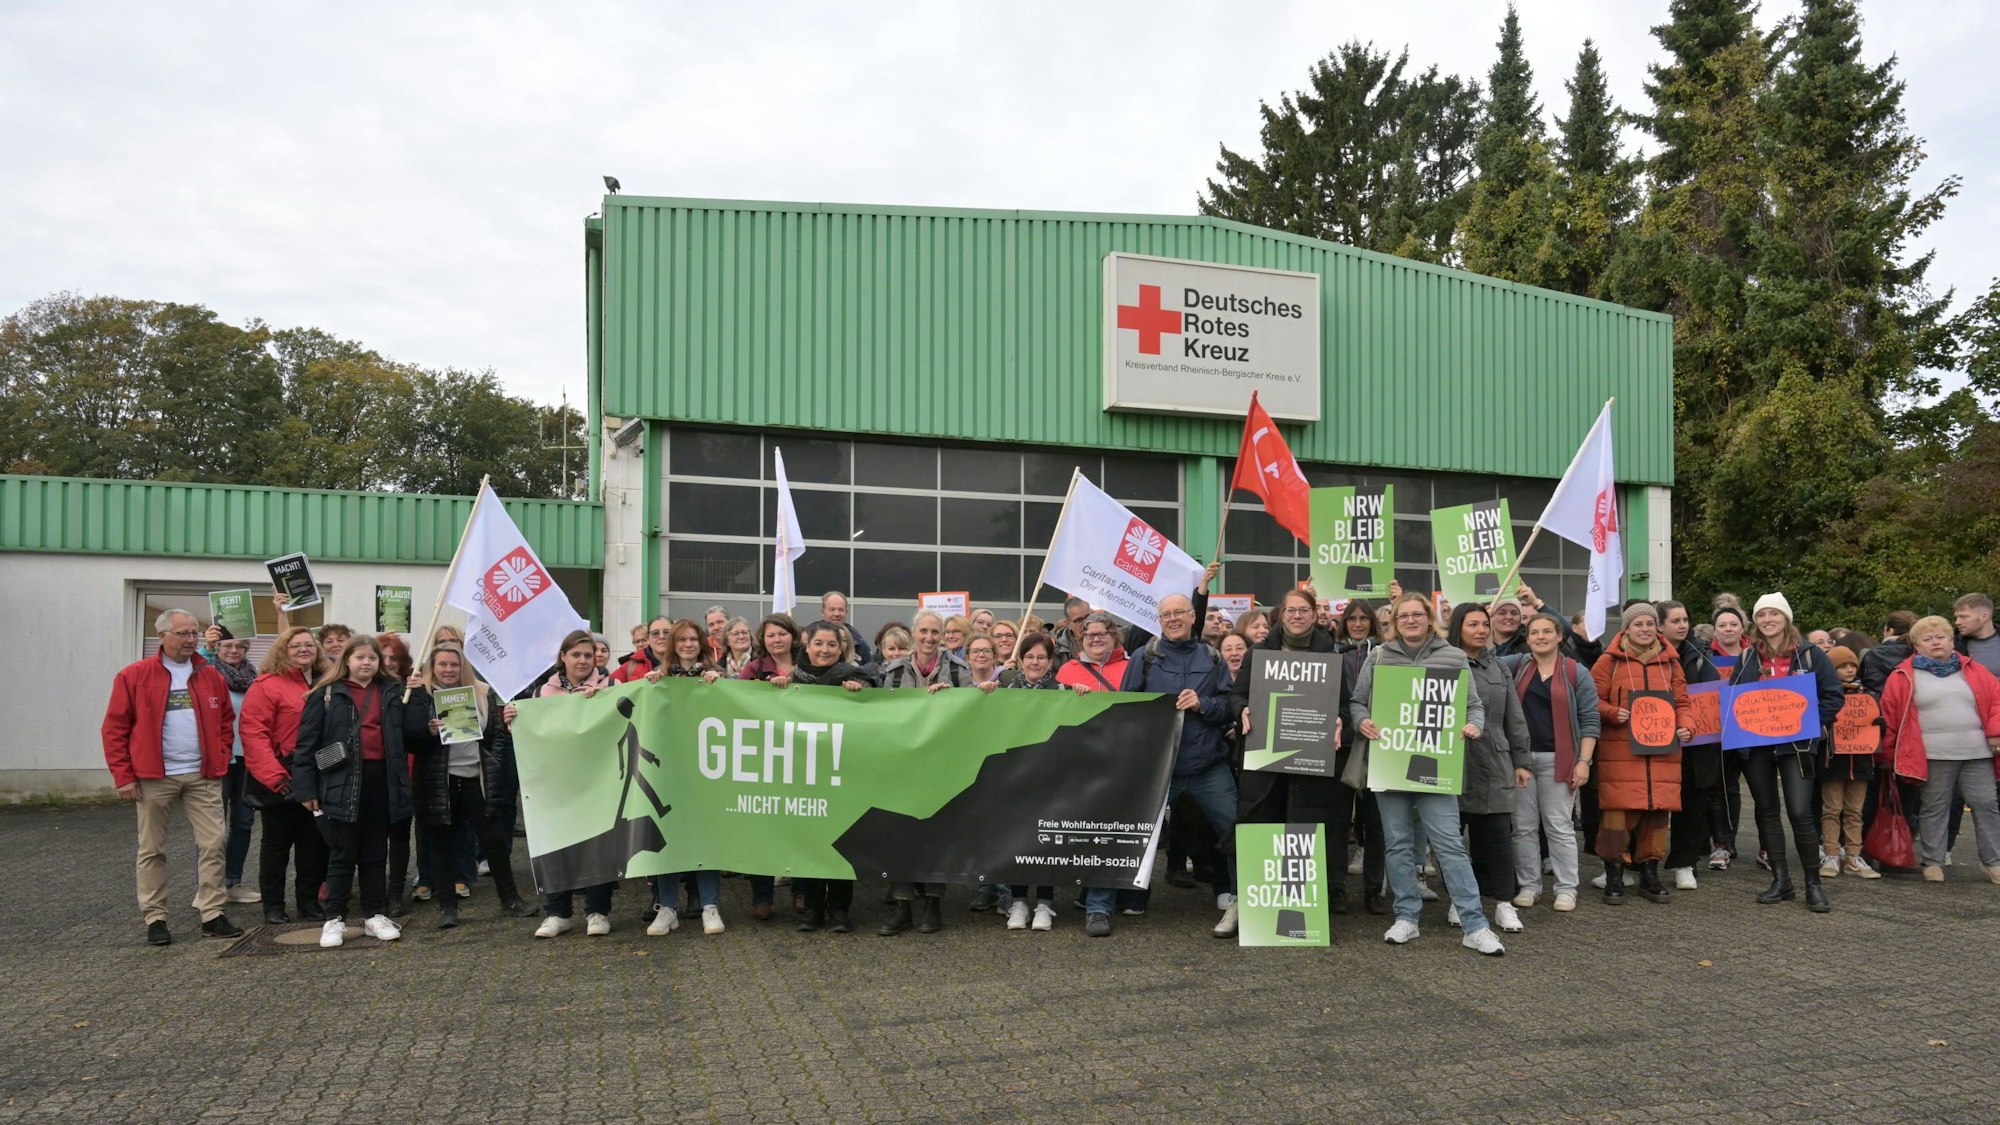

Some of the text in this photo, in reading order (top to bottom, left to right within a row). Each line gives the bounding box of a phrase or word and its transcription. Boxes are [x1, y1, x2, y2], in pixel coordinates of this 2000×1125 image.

[1184, 288, 1302, 319] Deutsches
[1184, 313, 1249, 338] Rotes
[1184, 338, 1250, 362] Kreuz
[1125, 360, 1302, 383] Kreisverband Rheinisch-Bergischer Kreis e.V.
[1344, 494, 1384, 517] NRW
[1334, 518, 1384, 540] BLEIB
[1463, 508, 1501, 532] NRW
[1458, 528, 1505, 553] BLEIB
[1318, 542, 1384, 564] SOZIAL!
[1446, 549, 1508, 576] SOZIAL!
[274, 561, 301, 574] MACHT!
[1116, 558, 1150, 582] caritas
[377, 590, 410, 599] APPLAUS!
[1080, 578, 1098, 592] Der
[1098, 588, 1136, 610] Mensch
[1082, 566, 1158, 608] Caritas RheinBe
[220, 595, 241, 605] GEHT!
[482, 588, 506, 618] aritas
[481, 624, 507, 658] inBerg
[1264, 660, 1327, 683] MACHT!
[441, 693, 468, 704] IMMER!
[1411, 678, 1458, 702] NRW
[1400, 702, 1456, 728] BLEIB
[698, 716, 844, 786] GEHT!
[1379, 727, 1454, 754] SOZIAL!
[726, 794, 828, 818] ...NICHT MEHR
[1038, 820, 1060, 828] Freie
[1060, 820, 1135, 832] Wohlfahrtspflege
[1272, 834, 1316, 856] NRW
[1015, 855, 1140, 868] www.nrw-bleib-sozial
[1264, 858, 1318, 882] BLEIB
[1247, 884, 1318, 908] SOZIAL!
